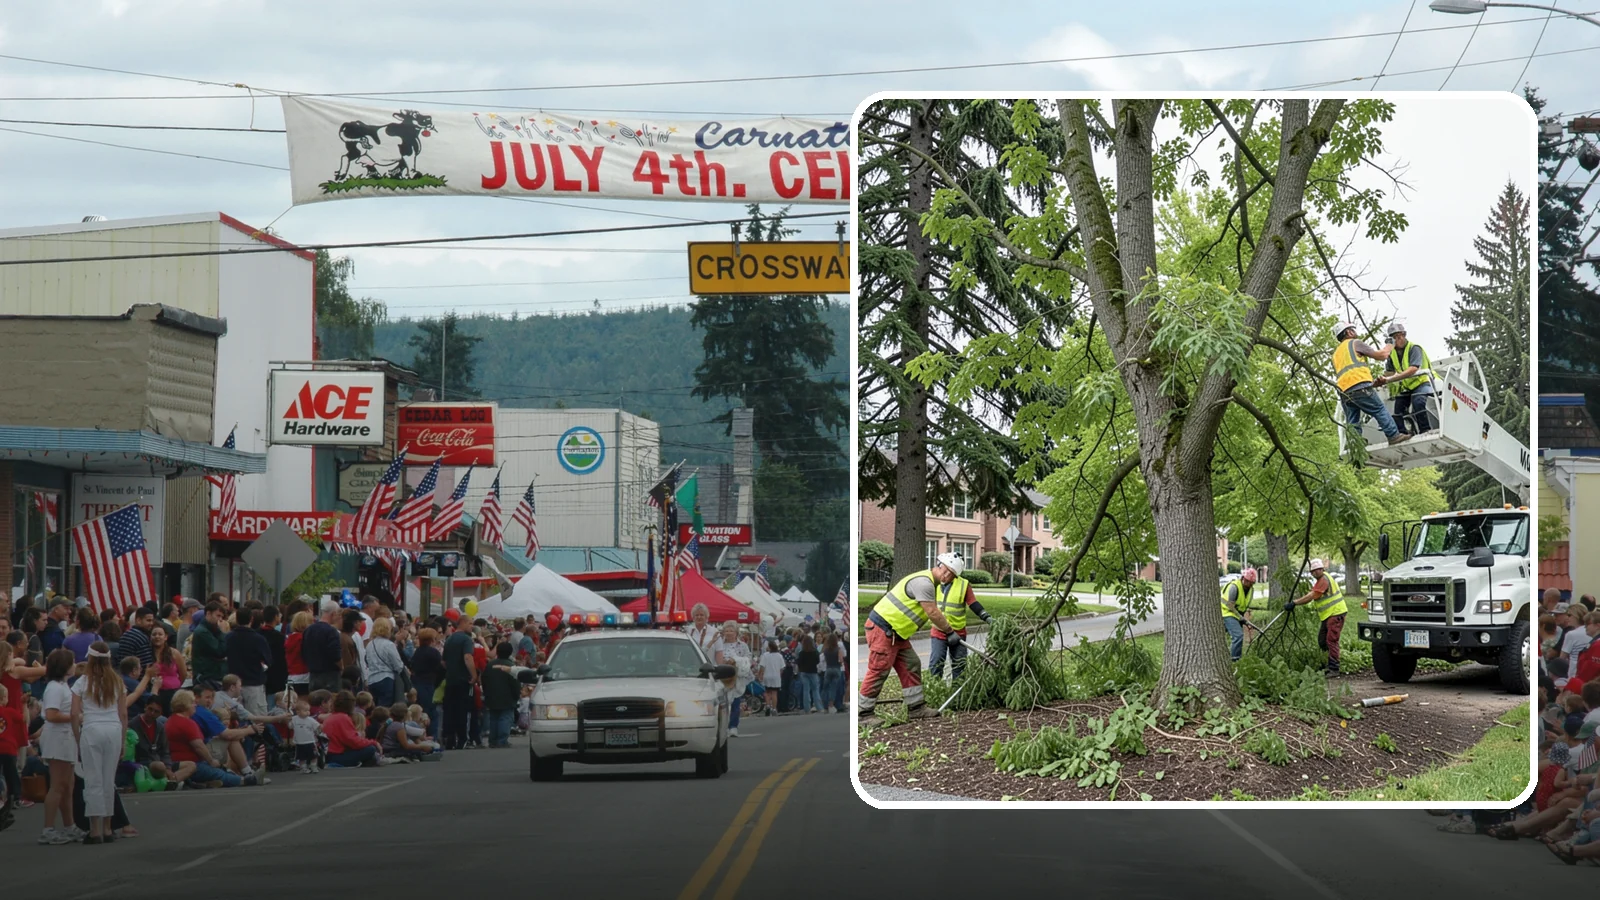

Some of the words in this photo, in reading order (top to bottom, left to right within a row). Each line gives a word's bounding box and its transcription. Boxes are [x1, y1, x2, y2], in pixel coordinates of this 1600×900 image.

[481, 141, 605, 192] JULY
[632, 150, 746, 198] 4th.
[697, 254, 850, 280] CROSSWA
[282, 380, 373, 420] ACE
[405, 409, 452, 422] CEDAR
[283, 421, 370, 436] Hardware
[416, 428, 477, 447] Coca-Cola
[353, 467, 384, 480] Simpl
[83, 484, 94, 495] St.
[95, 484, 124, 495] Vincent
[126, 485, 136, 495] de
[137, 486, 155, 496] Paul
[688, 527, 741, 535] CRNATION
[699, 535, 730, 543] GLASS
